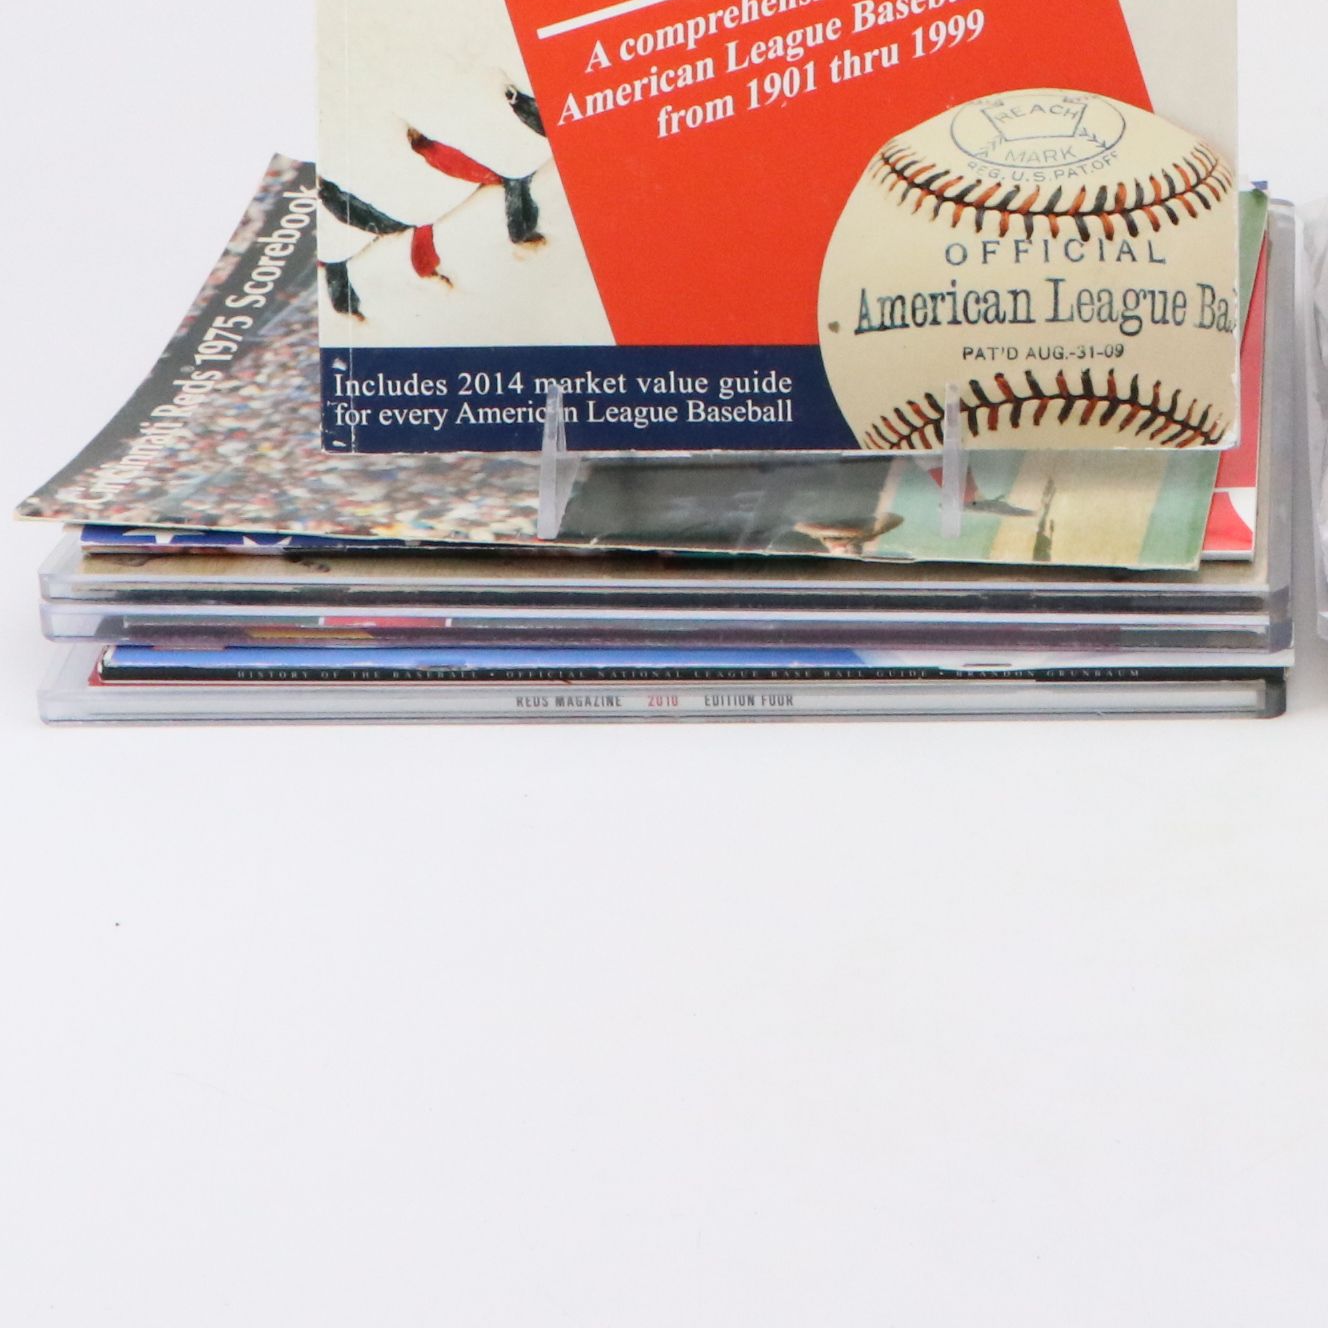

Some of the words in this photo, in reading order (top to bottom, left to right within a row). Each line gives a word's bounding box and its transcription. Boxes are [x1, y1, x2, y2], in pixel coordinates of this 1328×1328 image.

[557, 58, 715, 126] American
[726, 17, 842, 73] League
[585, 40, 609, 74] A
[656, 96, 734, 138] from
[747, 64, 817, 112] 1901
[829, 43, 900, 85] thru
[910, 9, 985, 58] 1999
[995, 104, 1079, 124] REACH
[1004, 145, 1078, 163] MARK
[945, 238, 1166, 267] OFFICIAL
[194, 315, 253, 365] 1975
[225, 185, 319, 308] Scorebook
[854, 279, 1036, 336] American
[1045, 278, 1188, 336] League
[962, 346, 1019, 361] PAT'D
[335, 373, 448, 396] Includes
[458, 373, 524, 395] 2014
[534, 372, 626, 395] market
[637, 371, 708, 394] value
[719, 370, 793, 399] guide
[335, 402, 371, 426] for
[379, 407, 446, 431] every
[587, 400, 678, 428] League
[687, 399, 793, 423] Baseball
[237, 671, 309, 679] HISTORY
[352, 671, 380, 679] THE
[393, 670, 477, 679] BASEBALL
[506, 671, 584, 679] OFFICIAL
[600, 671, 681, 679] NATIONAL
[694, 671, 758, 679] LEAGUE
[771, 670, 812, 678] BASE
[824, 670, 862, 678] BALL
[876, 669, 928, 678] GUIDE
[955, 669, 1035, 678] BRANDON
[516, 695, 549, 708] REDS
[555, 695, 622, 707] MAGAZINE
[647, 694, 679, 707] 2010
[704, 694, 756, 707] EDITION
[761, 694, 794, 706] FOUR
